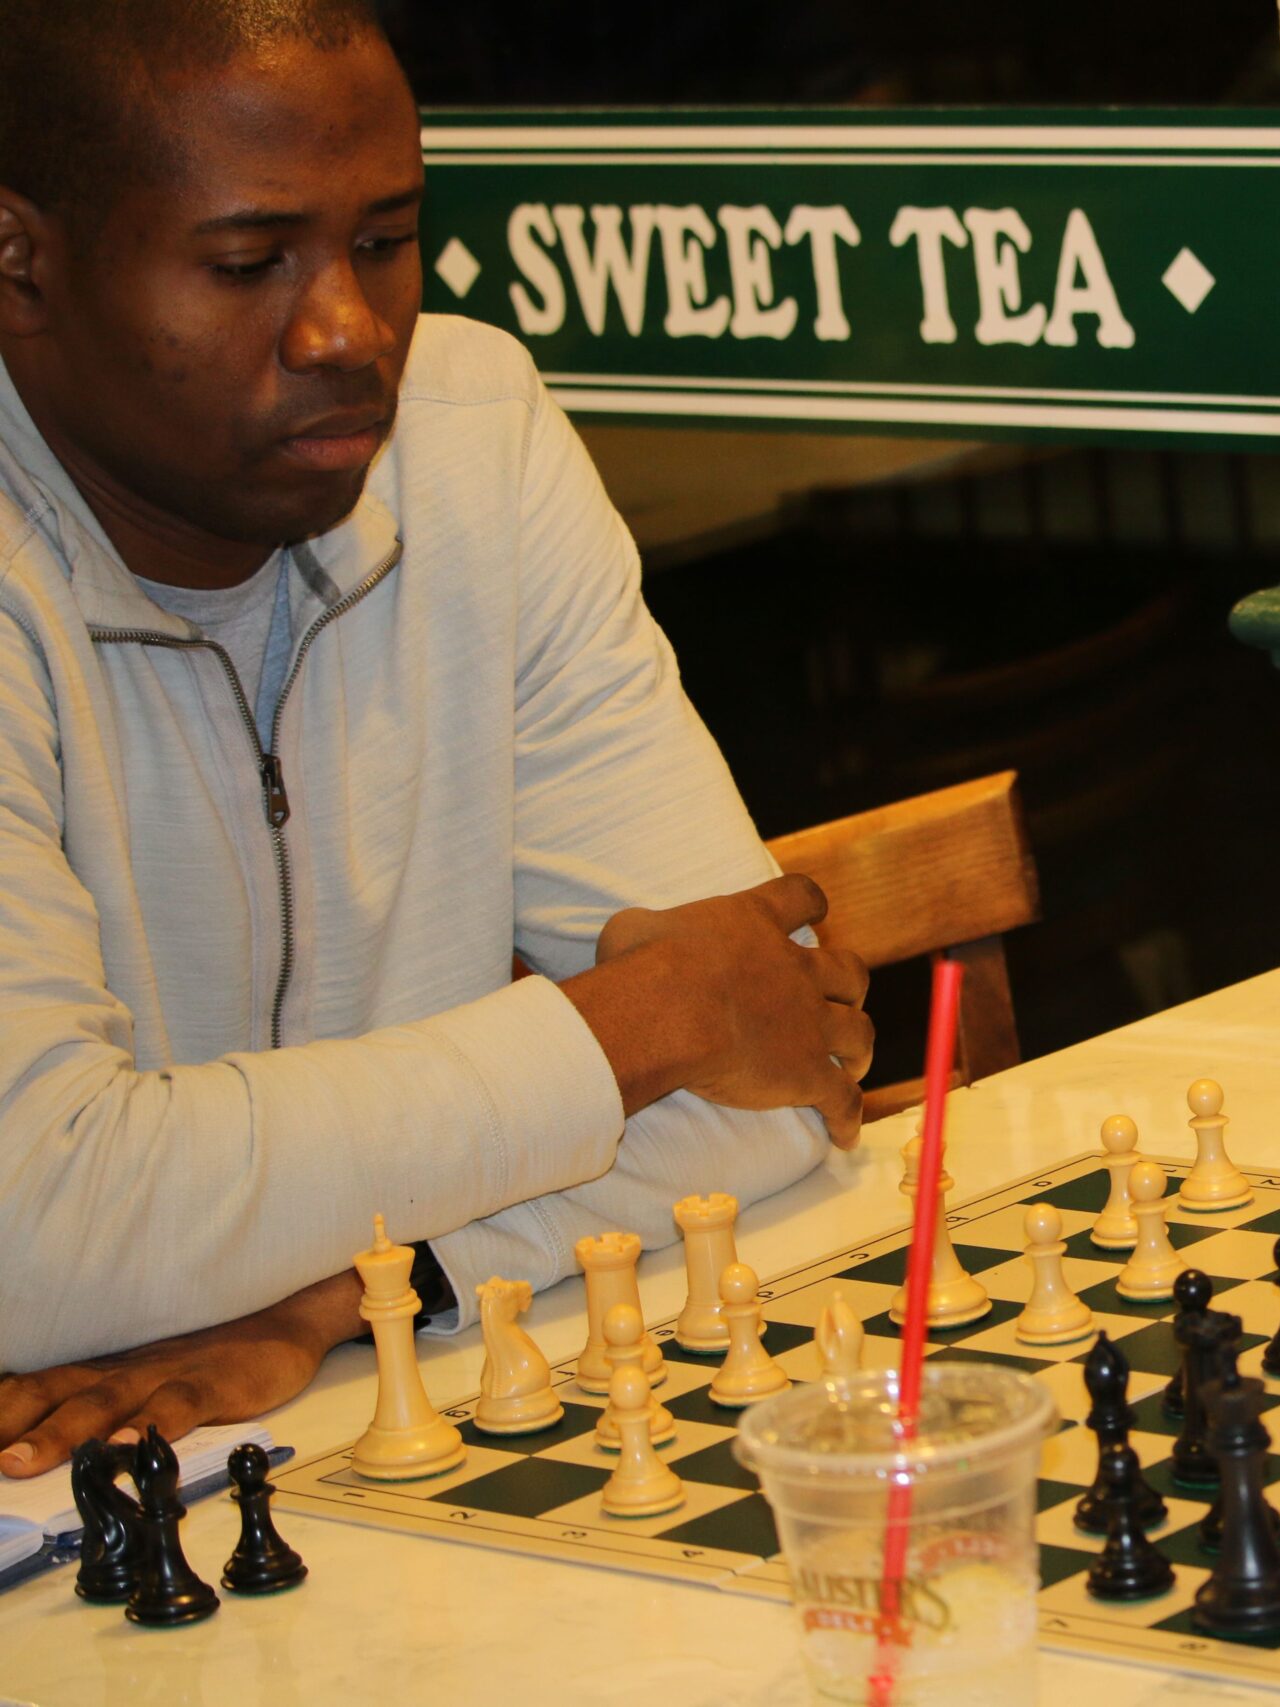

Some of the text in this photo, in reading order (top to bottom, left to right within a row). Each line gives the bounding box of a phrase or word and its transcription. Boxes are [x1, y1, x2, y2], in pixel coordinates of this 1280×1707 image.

[507, 202, 1136, 350] SWEET TEA
[850, 1252, 869, 1260] c
[449, 1511, 477, 1520] 2
